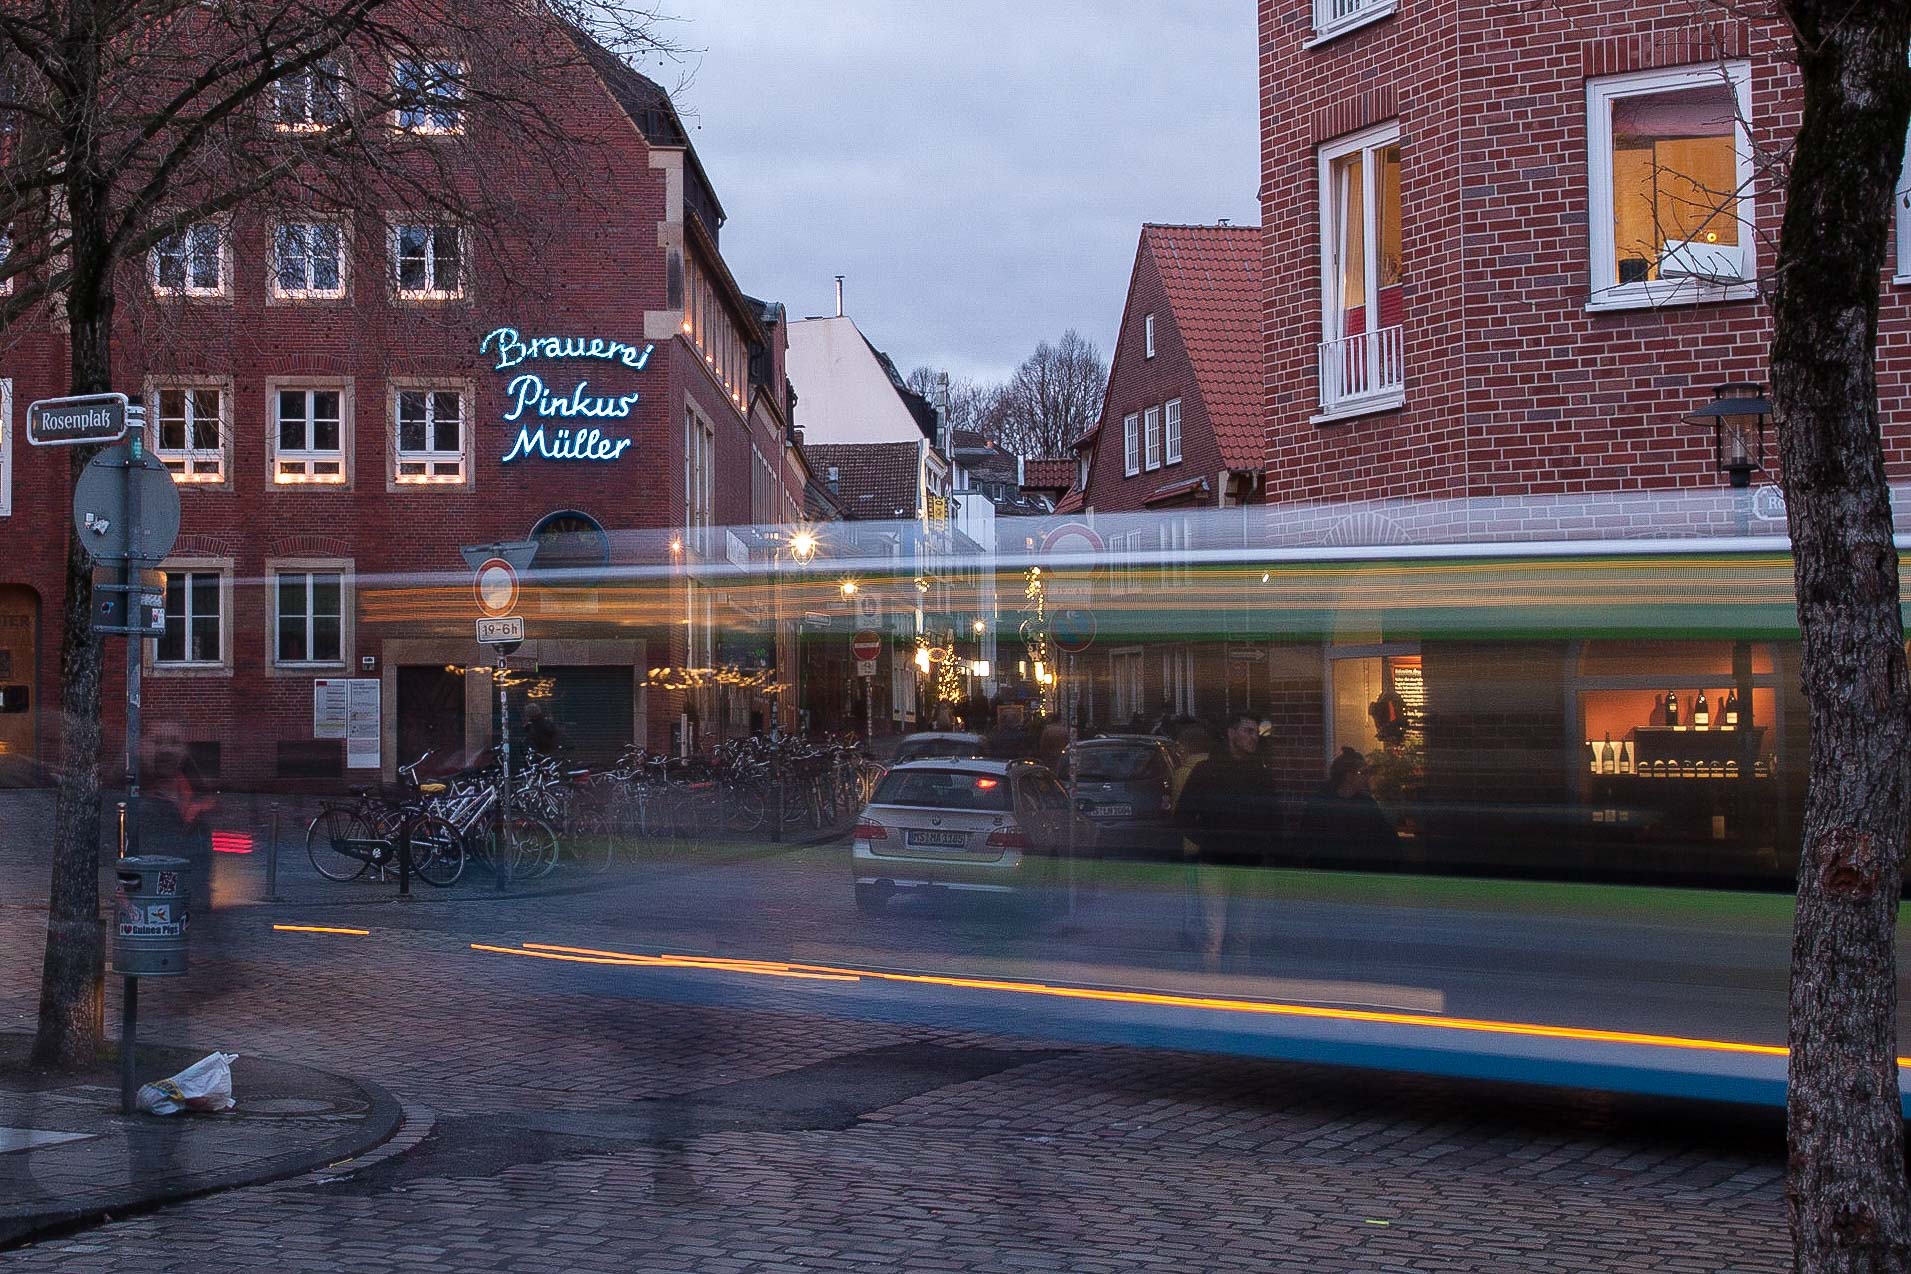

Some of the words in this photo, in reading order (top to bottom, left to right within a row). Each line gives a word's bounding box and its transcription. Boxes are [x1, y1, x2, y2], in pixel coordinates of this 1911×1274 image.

[480, 326, 654, 371] Brauerei
[502, 374, 640, 421] Pinkus
[502, 424, 632, 462] Müller
